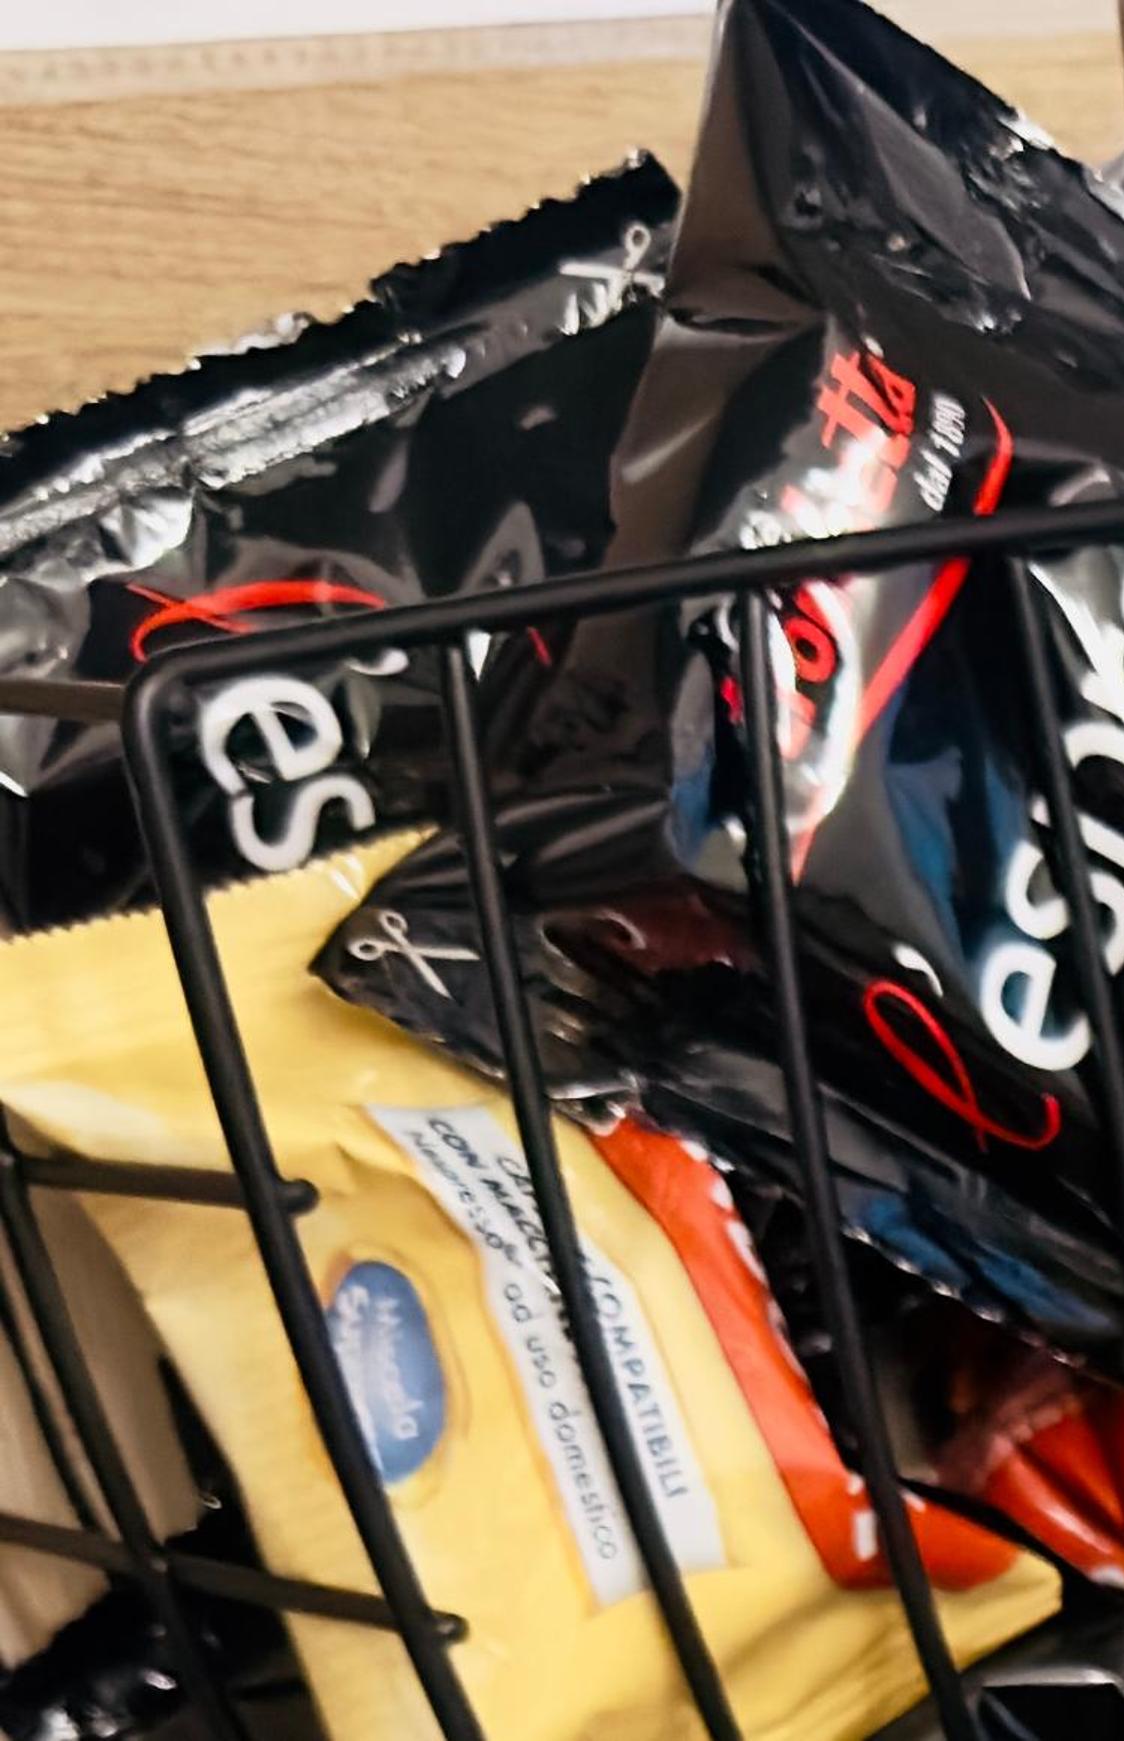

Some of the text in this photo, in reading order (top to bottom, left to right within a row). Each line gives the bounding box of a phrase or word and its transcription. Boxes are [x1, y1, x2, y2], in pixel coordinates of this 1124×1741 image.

[914, 391, 968, 512] dal 1890
[427, 1117, 486, 1169] CON
[504, 1282, 542, 1324] ad
[526, 1336, 557, 1388] uso
[548, 1401, 618, 1560] domestico
